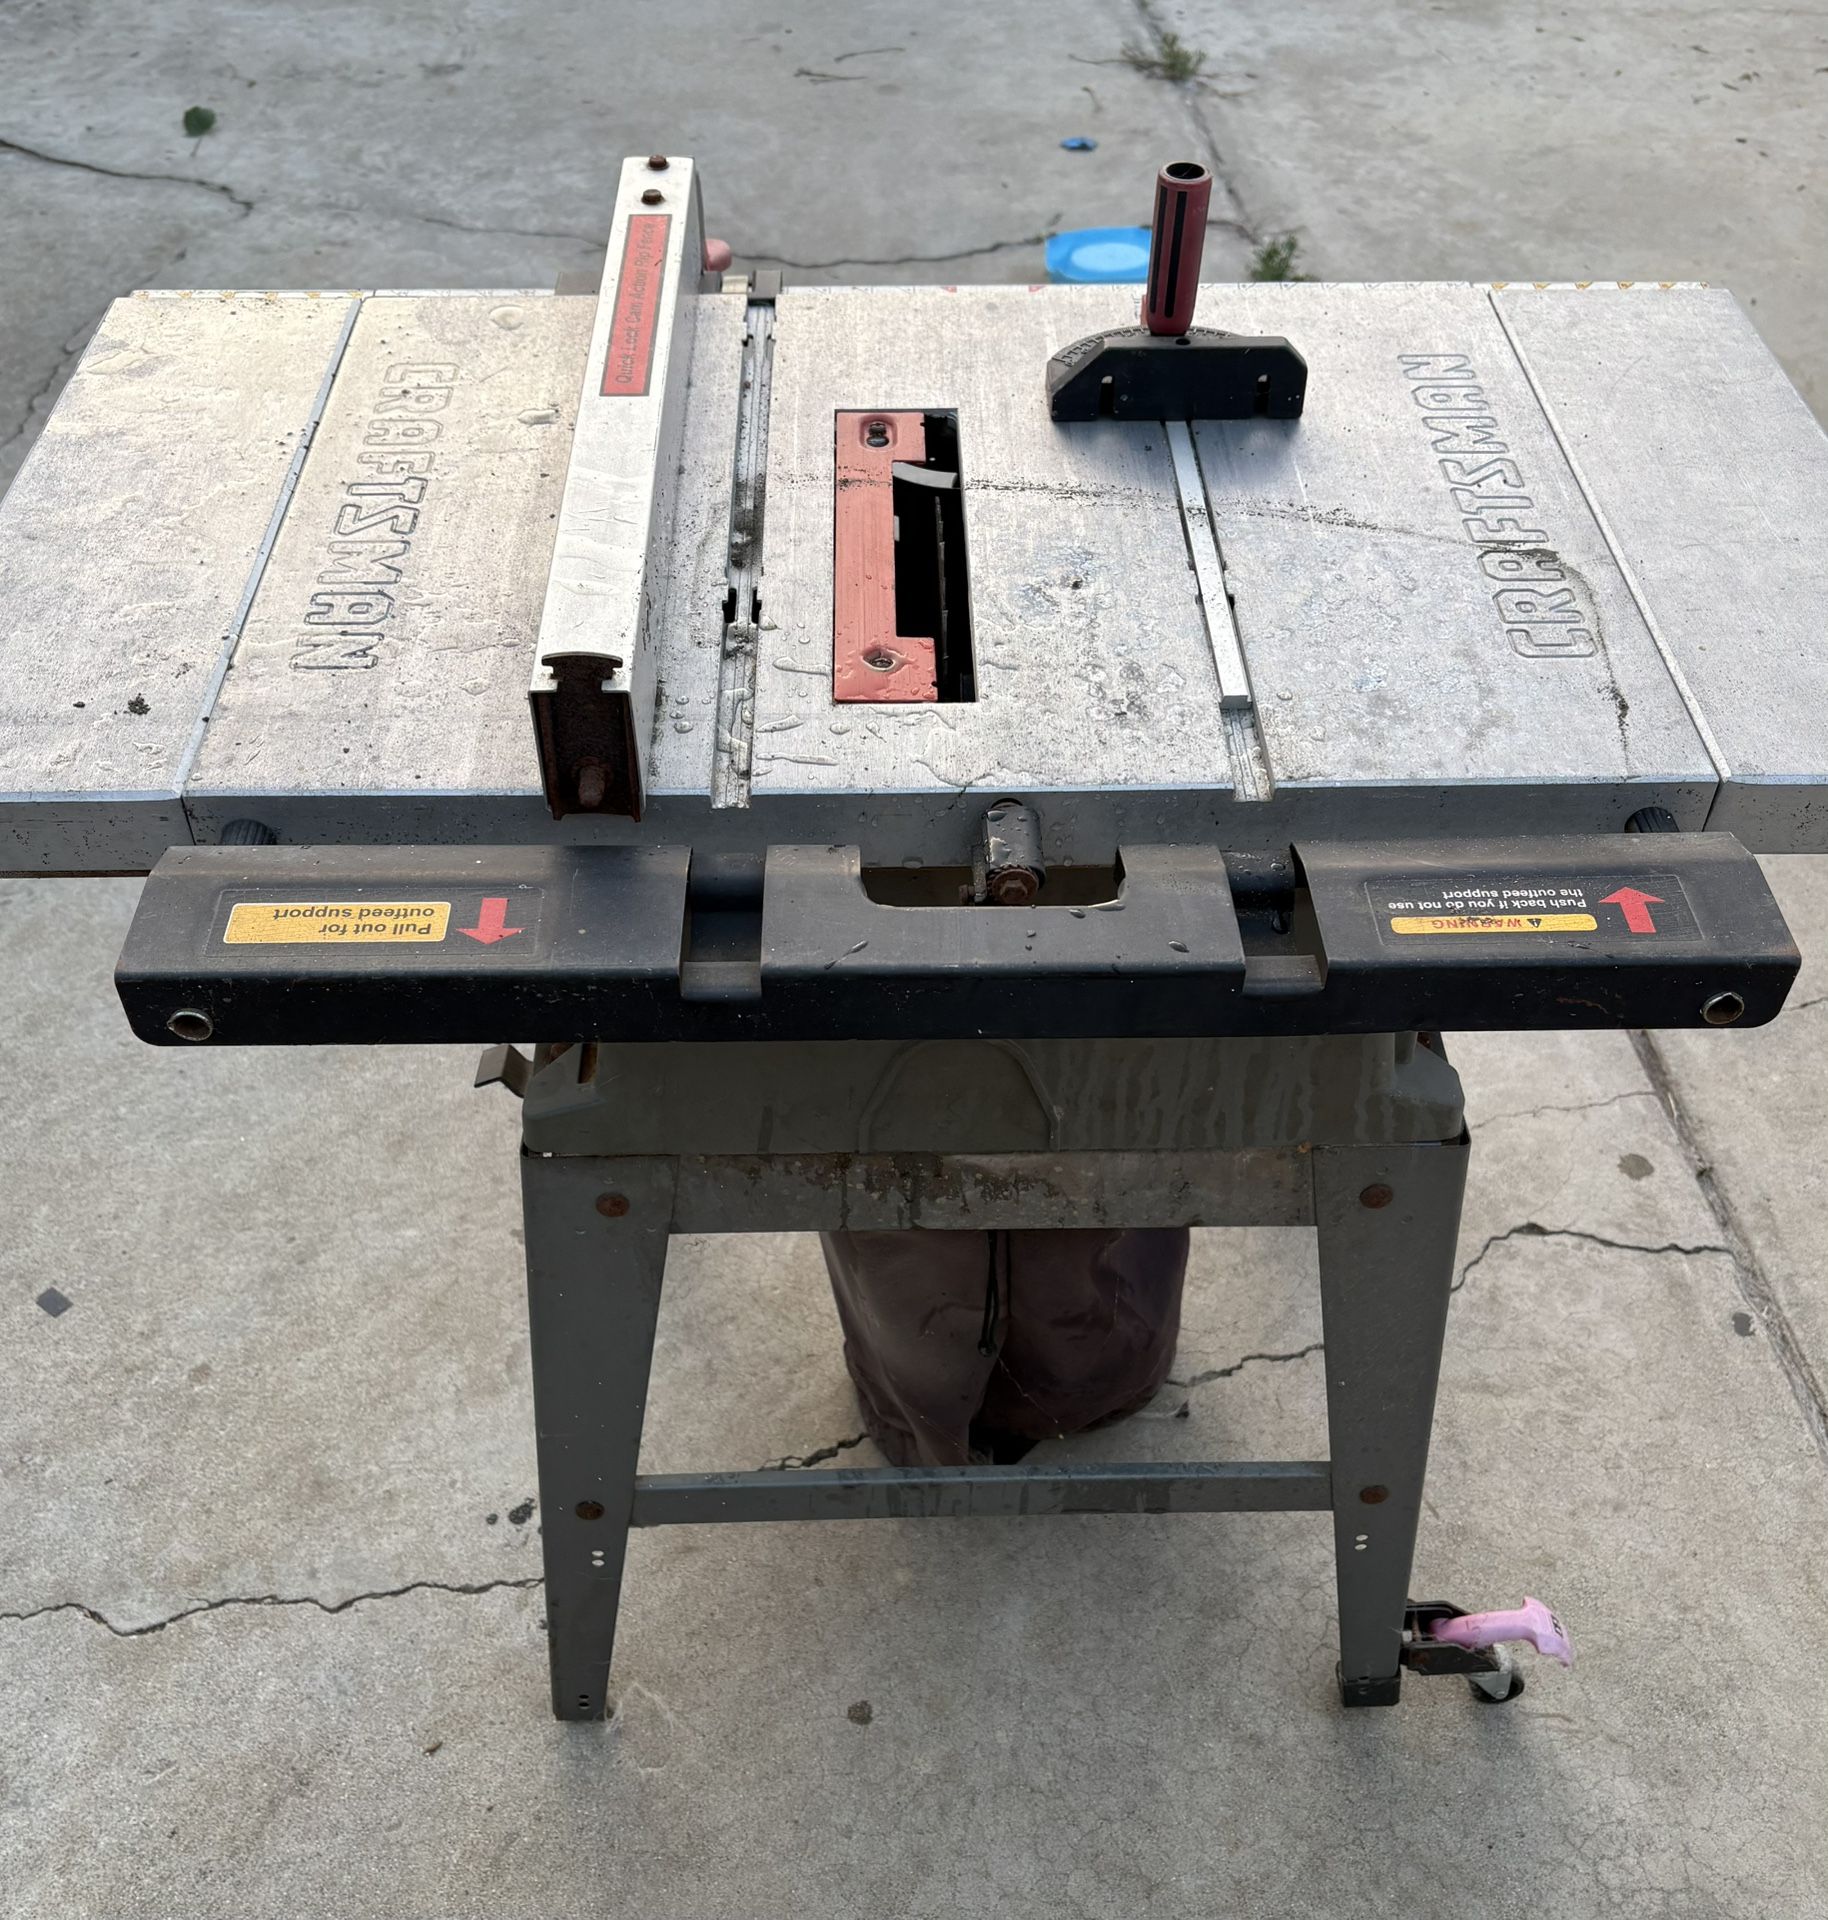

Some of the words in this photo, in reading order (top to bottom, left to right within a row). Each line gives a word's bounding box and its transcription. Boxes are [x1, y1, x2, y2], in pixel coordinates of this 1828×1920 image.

[637, 222, 656, 249] Fence
[634, 251, 653, 267] Rip
[630, 269, 648, 299] Action
[625, 302, 644, 324] Cam
[622, 327, 640, 351] Lock
[615, 353, 636, 384] Quick
[1397, 354, 1599, 659] CRAFTSMAN
[290, 362, 460, 670] CRAFTSMAN
[1442, 888, 1499, 899] support
[1504, 889, 1556, 899] outfeed
[1561, 889, 1583, 898] the
[1388, 902, 1414, 910] use
[1419, 901, 1442, 911] not
[1445, 901, 1465, 910] do
[1468, 898, 1496, 909] you
[1498, 899, 1509, 910] if
[1513, 898, 1549, 909] back
[1553, 898, 1587, 908] Push
[273, 906, 352, 919] support
[358, 907, 435, 920] outfeed
[1432, 917, 1522, 928] WARNING
[318, 923, 347, 936] for
[353, 923, 387, 935] out
[392, 923, 431, 935] Pull
